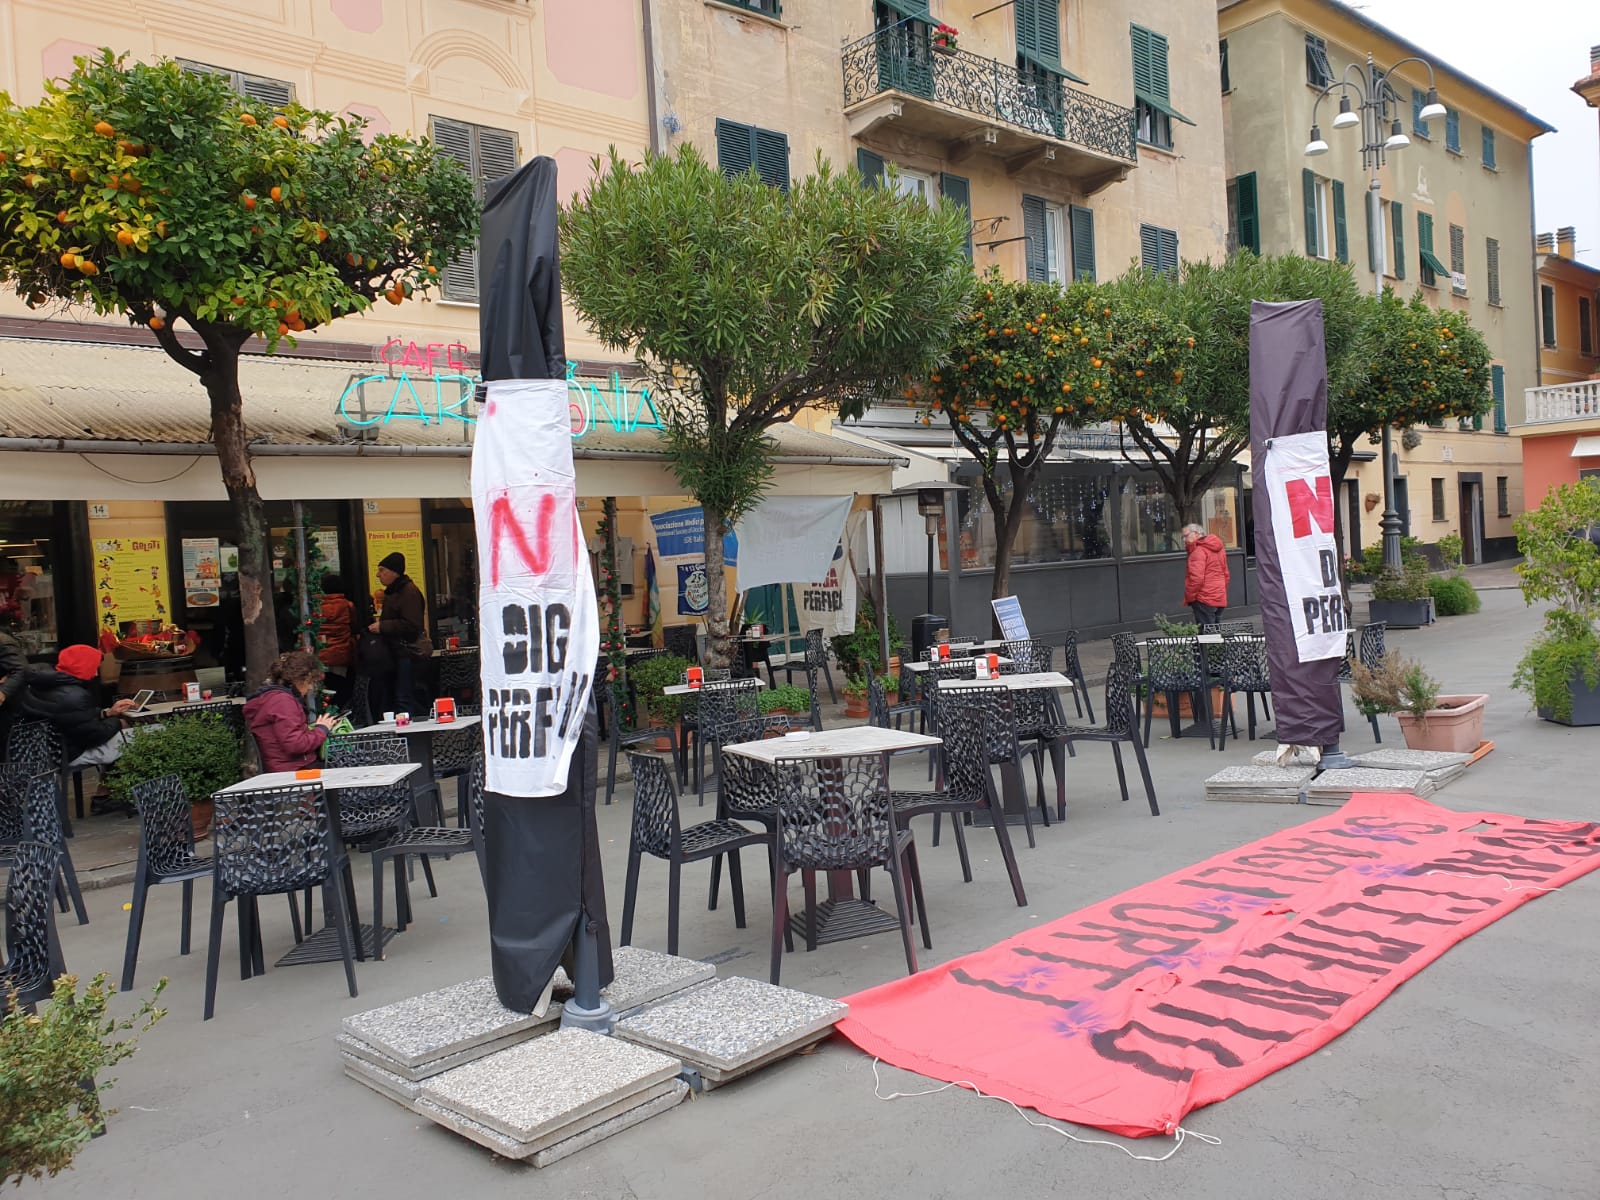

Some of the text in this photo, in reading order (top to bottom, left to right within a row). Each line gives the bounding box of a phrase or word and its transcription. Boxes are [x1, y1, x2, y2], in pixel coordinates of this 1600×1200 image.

[94, 505, 105, 514] 14
[491, 493, 566, 589] N
[1302, 594, 1345, 634] PER
